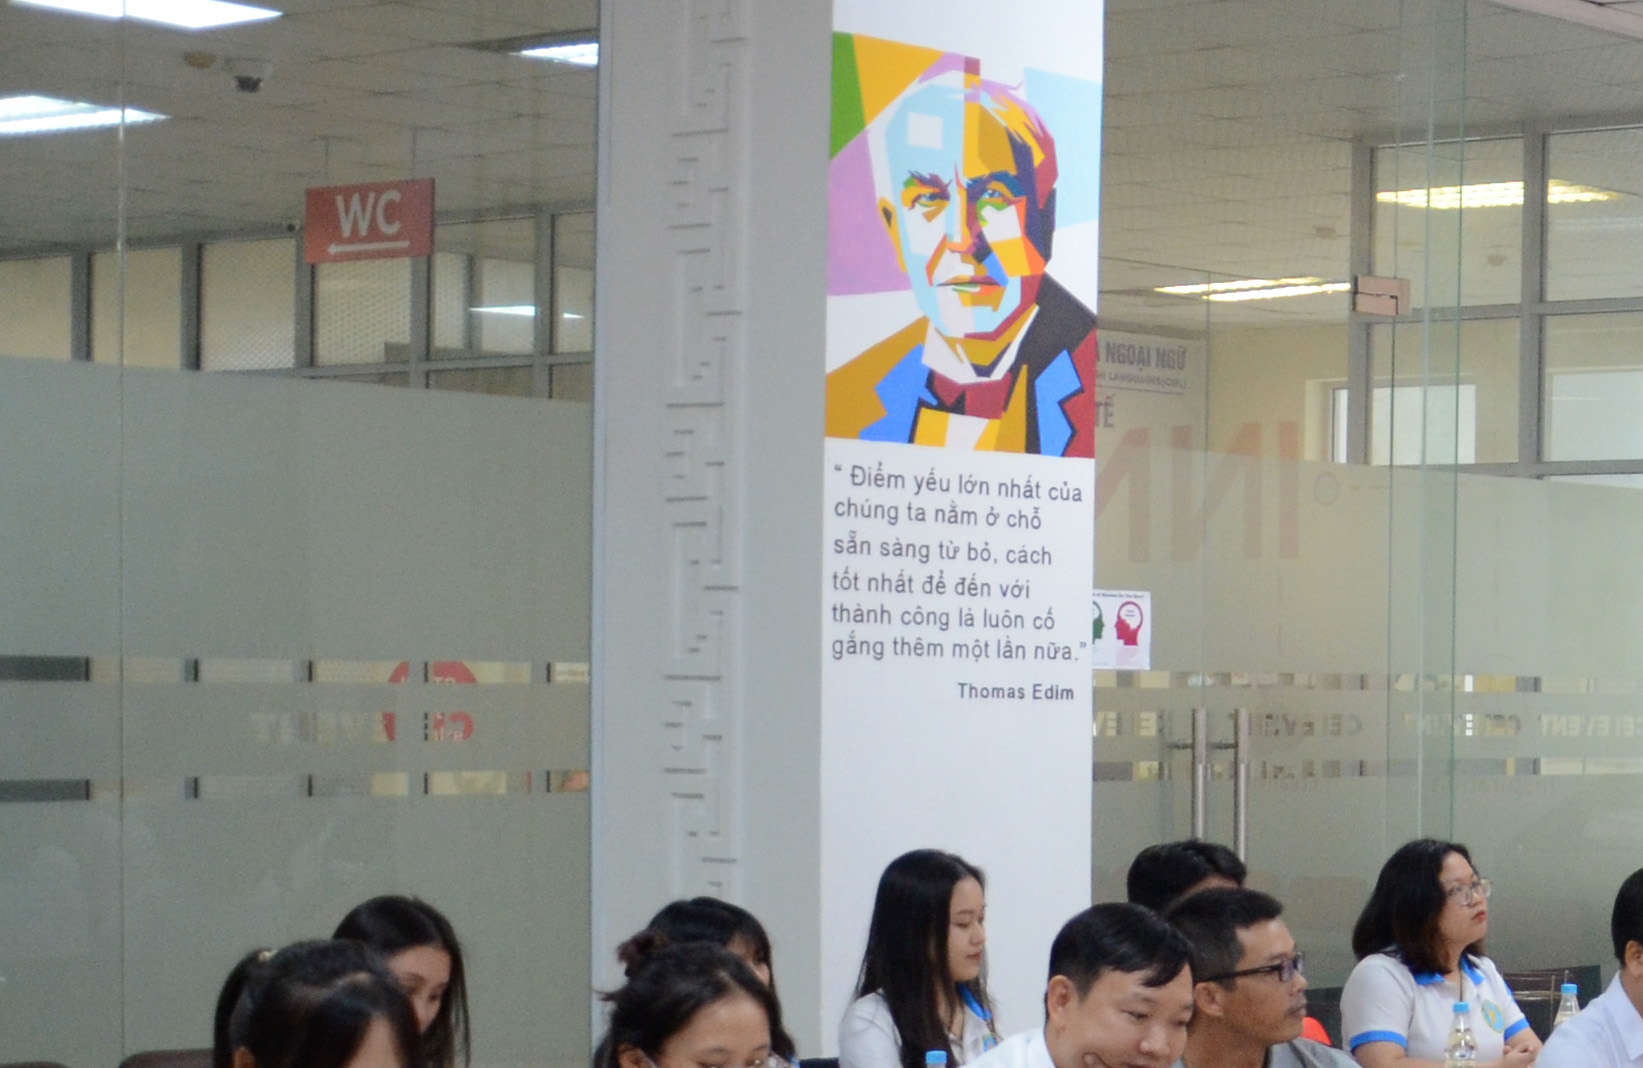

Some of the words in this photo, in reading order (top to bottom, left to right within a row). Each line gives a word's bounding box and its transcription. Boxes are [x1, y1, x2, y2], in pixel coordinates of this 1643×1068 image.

[335, 189, 402, 238] WC
[850, 461, 905, 490] Điểm
[914, 467, 951, 496] yếu
[958, 474, 990, 496] lớn
[998, 474, 1041, 500] nhất
[1048, 481, 1083, 502] của
[834, 497, 899, 526] chúng
[907, 505, 926, 523] ta
[934, 500, 978, 526] nằm
[985, 506, 1000, 527] ở
[1006, 506, 1042, 530] chỗ
[833, 530, 871, 556] sẵn
[879, 537, 930, 563] sàng
[938, 540, 960, 560] từ
[967, 541, 998, 564] bỏ,
[1005, 547, 1052, 566] cách
[832, 566, 860, 591] tốt
[867, 569, 914, 594] nhất
[922, 570, 947, 595] để
[954, 573, 991, 597] đến
[999, 578, 1030, 599] với
[832, 604, 892, 625] thành
[901, 606, 950, 631] công
[959, 607, 975, 628] là
[983, 608, 1025, 630] luôn
[1032, 607, 1055, 630] cố
[832, 630, 885, 660] gắng
[893, 637, 944, 658] thêm
[952, 639, 991, 663] một
[997, 635, 1026, 660] lần
[957, 682, 1025, 701] Thomas
[1032, 683, 1074, 701] Edim
